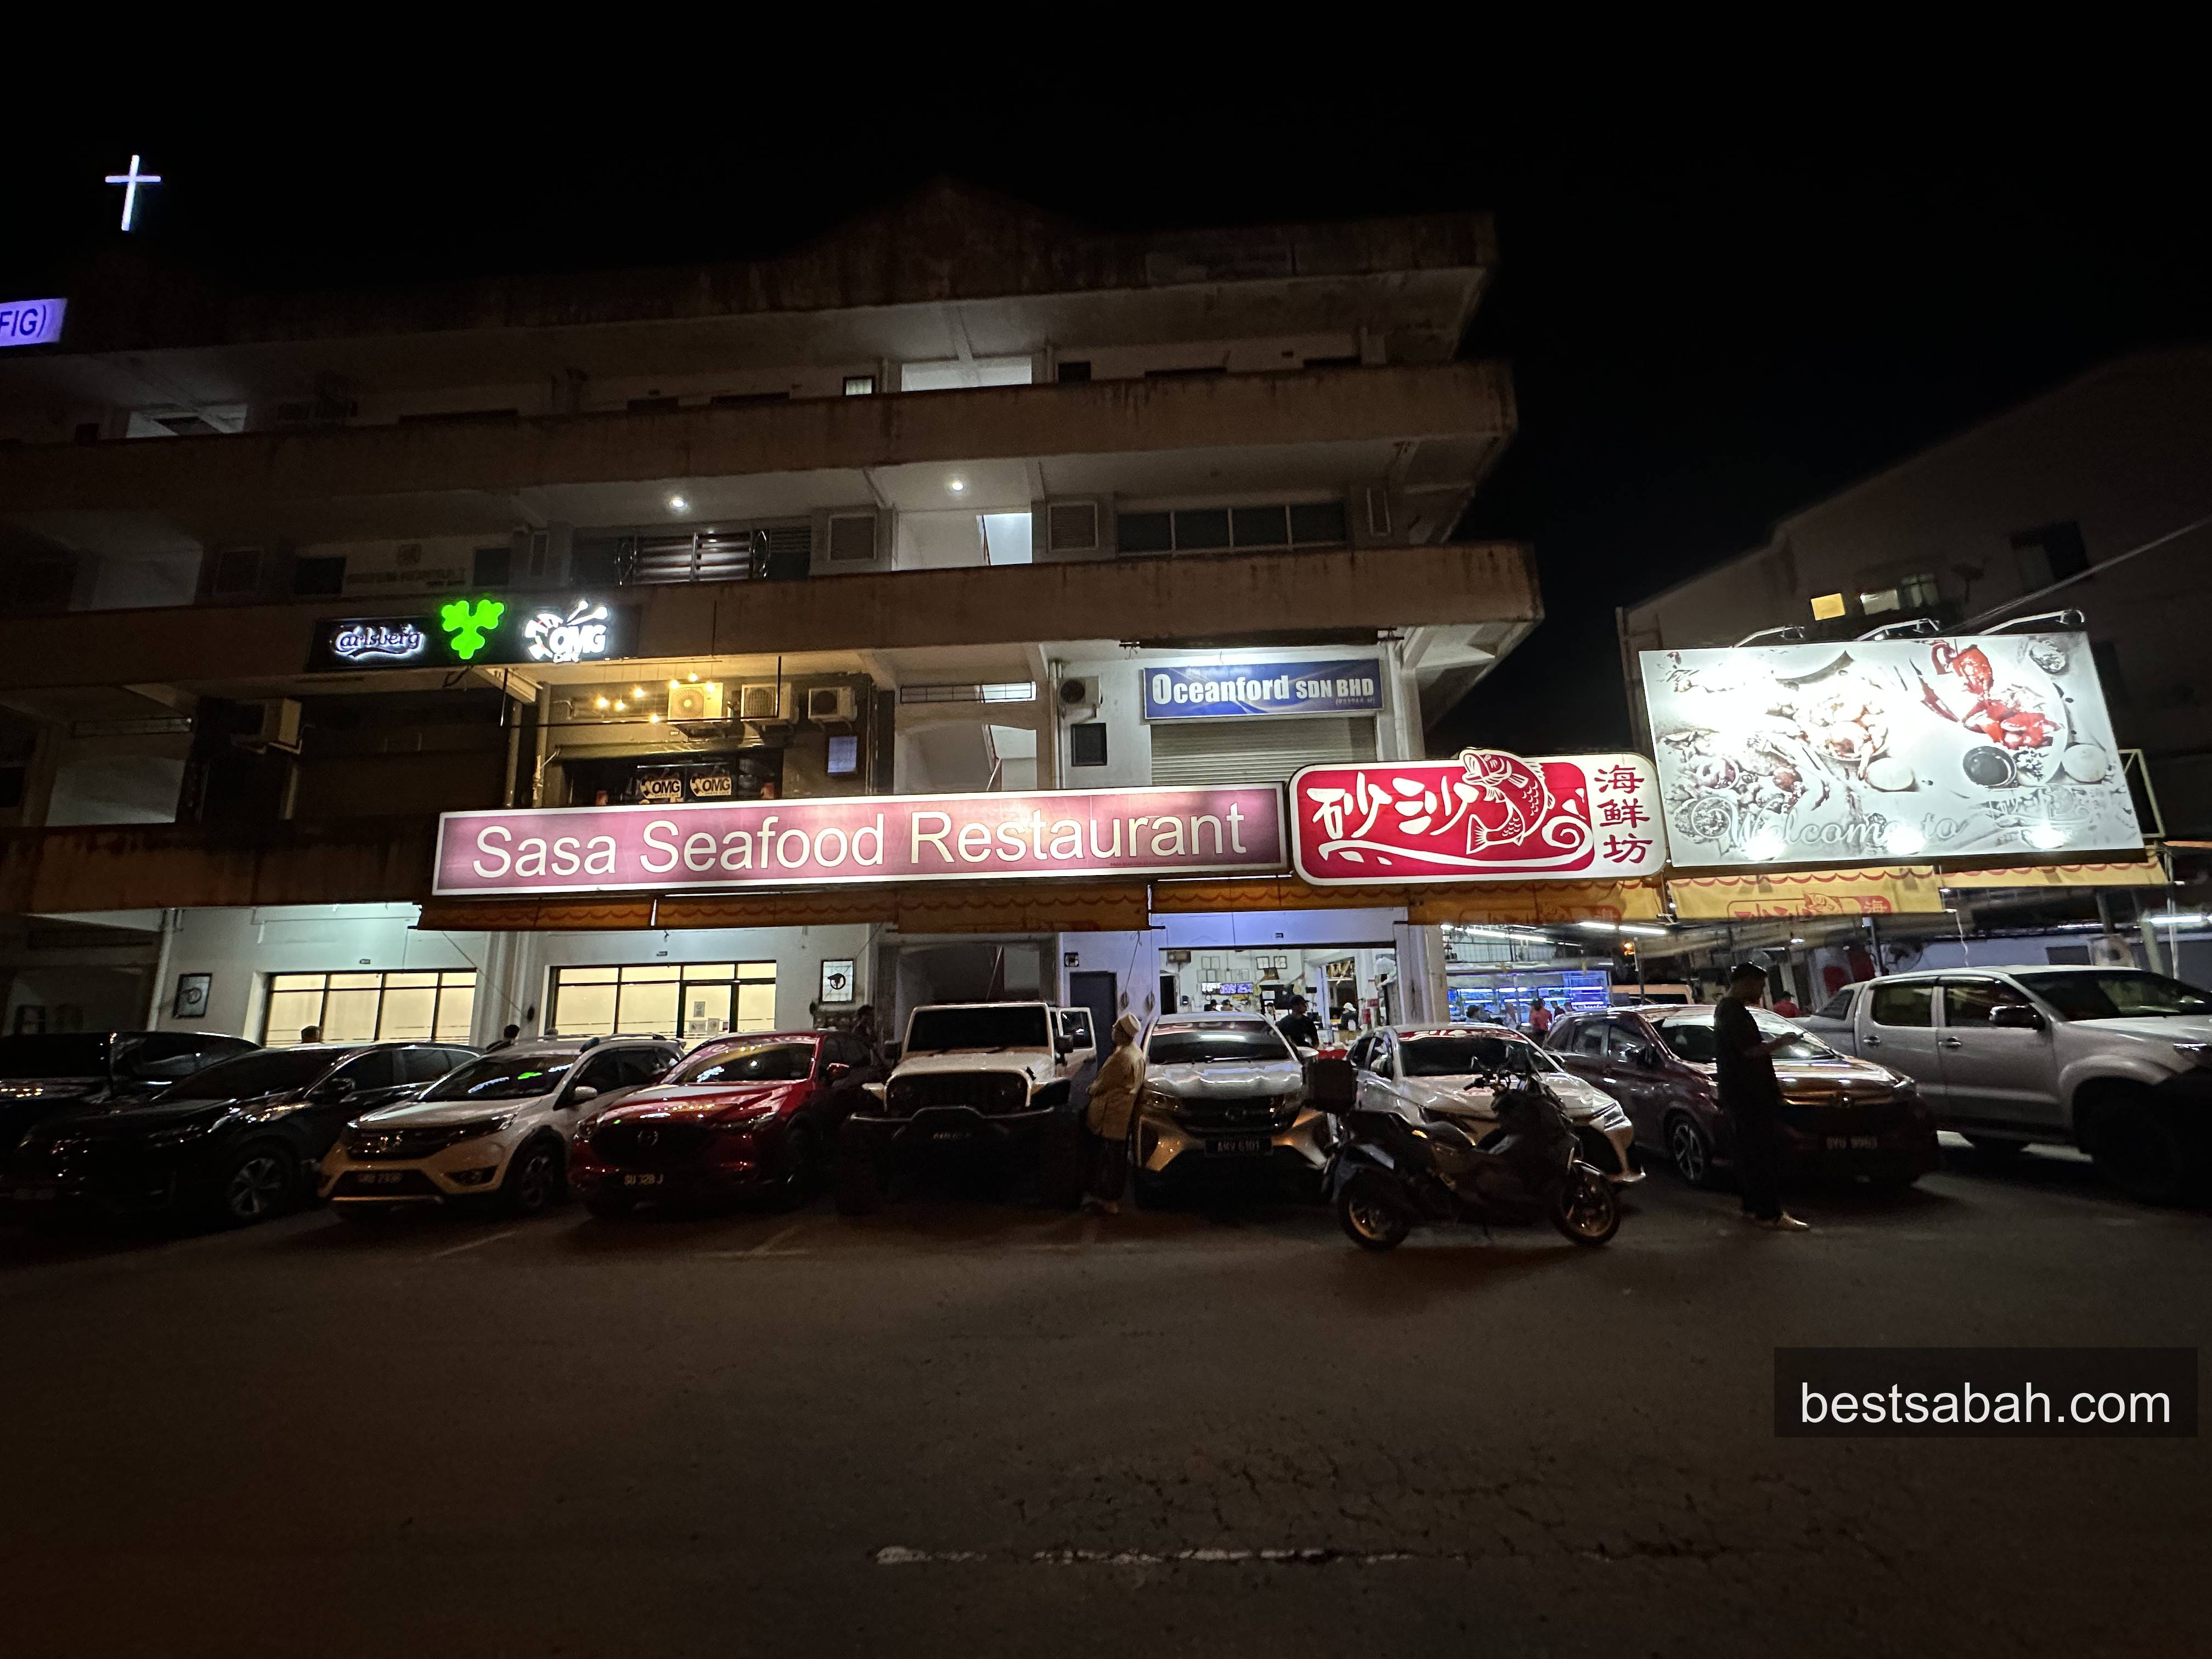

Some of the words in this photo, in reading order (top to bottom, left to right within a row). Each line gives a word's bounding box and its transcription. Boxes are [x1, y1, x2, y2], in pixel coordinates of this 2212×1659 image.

[549, 624, 607, 654] OMG
[1152, 673, 1289, 705] Oceanford
[1296, 679, 1333, 698] SDN
[1336, 678, 1374, 697] BHD
[652, 780, 680, 793] OMG
[702, 778, 730, 792] OMG
[472, 826, 617, 878] Sasa
[640, 813, 885, 873] Seafood
[911, 802, 1246, 865] Restaurant
